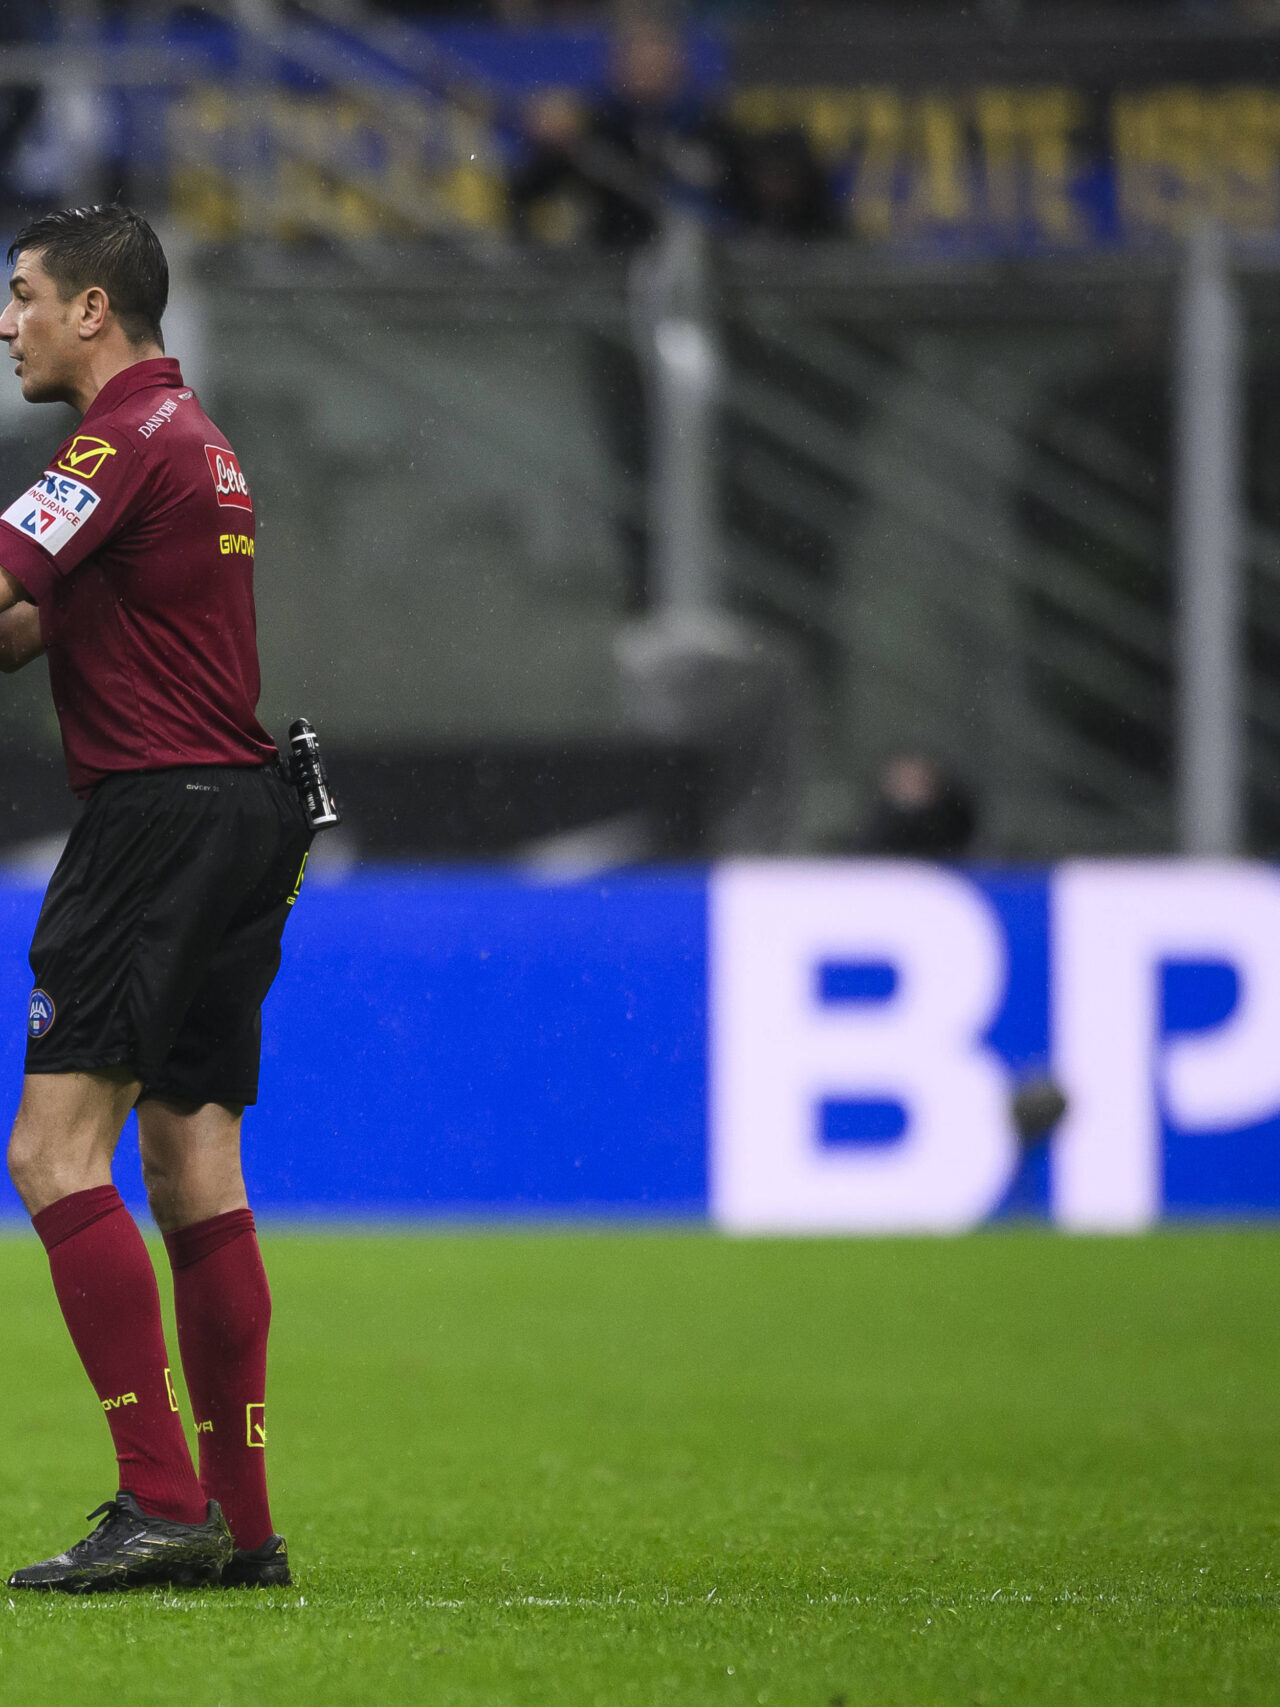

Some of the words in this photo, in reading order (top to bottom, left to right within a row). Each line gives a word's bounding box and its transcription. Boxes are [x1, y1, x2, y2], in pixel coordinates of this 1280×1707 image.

[137, 414, 165, 440] DAN
[155, 398, 178, 423] JOHN
[216, 454, 248, 496] Lete
[27, 489, 81, 527] INSURANCE
[710, 858, 1280, 1235] BP
